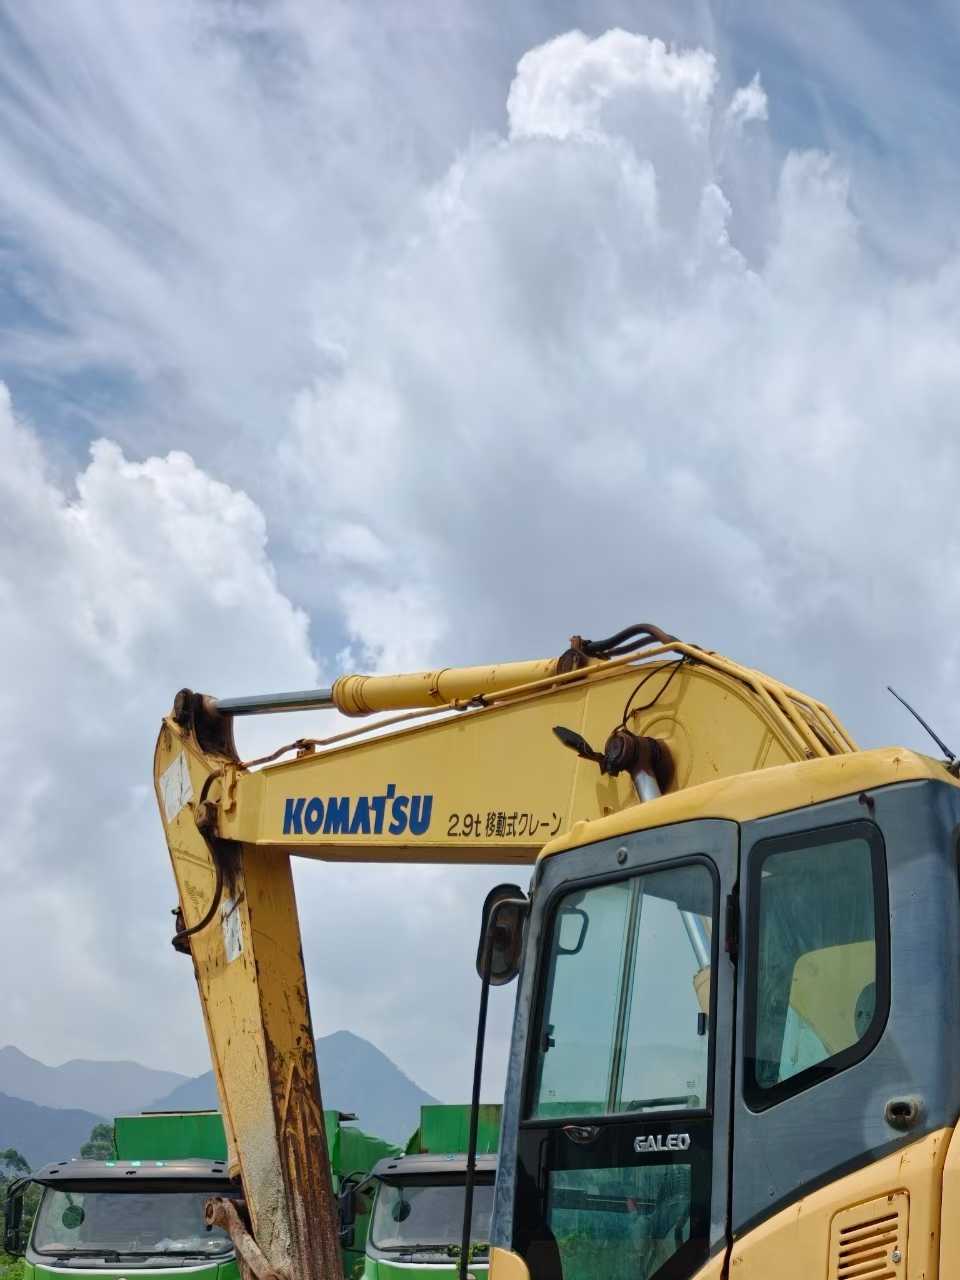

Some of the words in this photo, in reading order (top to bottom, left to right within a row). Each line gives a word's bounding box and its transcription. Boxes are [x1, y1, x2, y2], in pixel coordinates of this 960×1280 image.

[283, 784, 433, 836] KOMATSU
[447, 812, 482, 837] 2.9t
[485, 811, 562, 838] 移動式クレーン
[633, 1133, 691, 1153] GALEO
